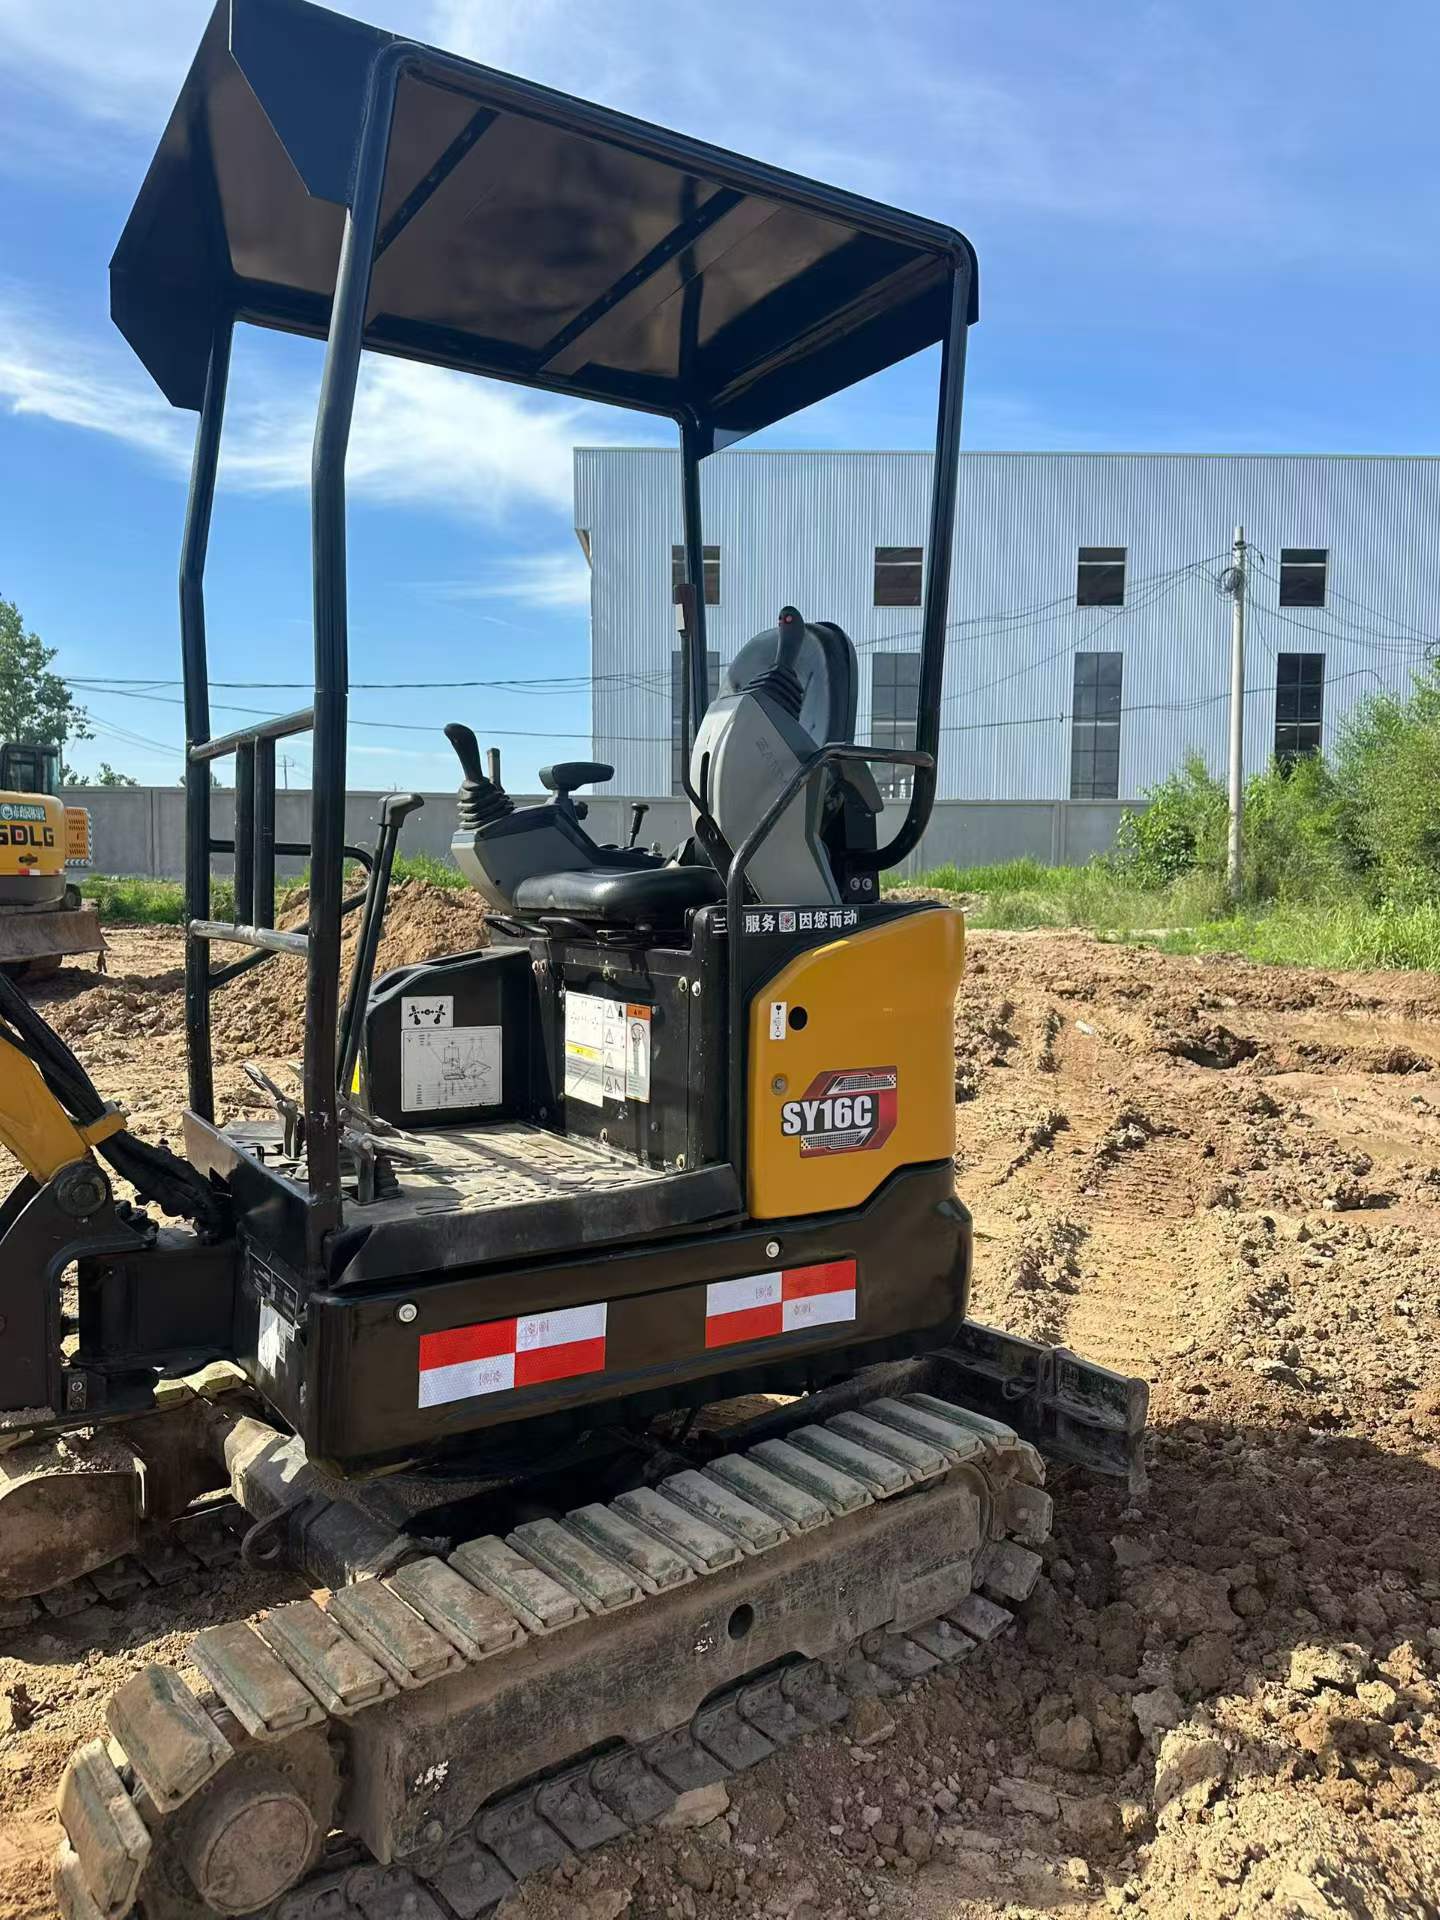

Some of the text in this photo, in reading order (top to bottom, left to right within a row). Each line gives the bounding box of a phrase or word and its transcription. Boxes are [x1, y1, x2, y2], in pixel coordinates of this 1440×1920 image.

[799, 910, 858, 929] 因您而动
[783, 1095, 872, 1134] SY16C
